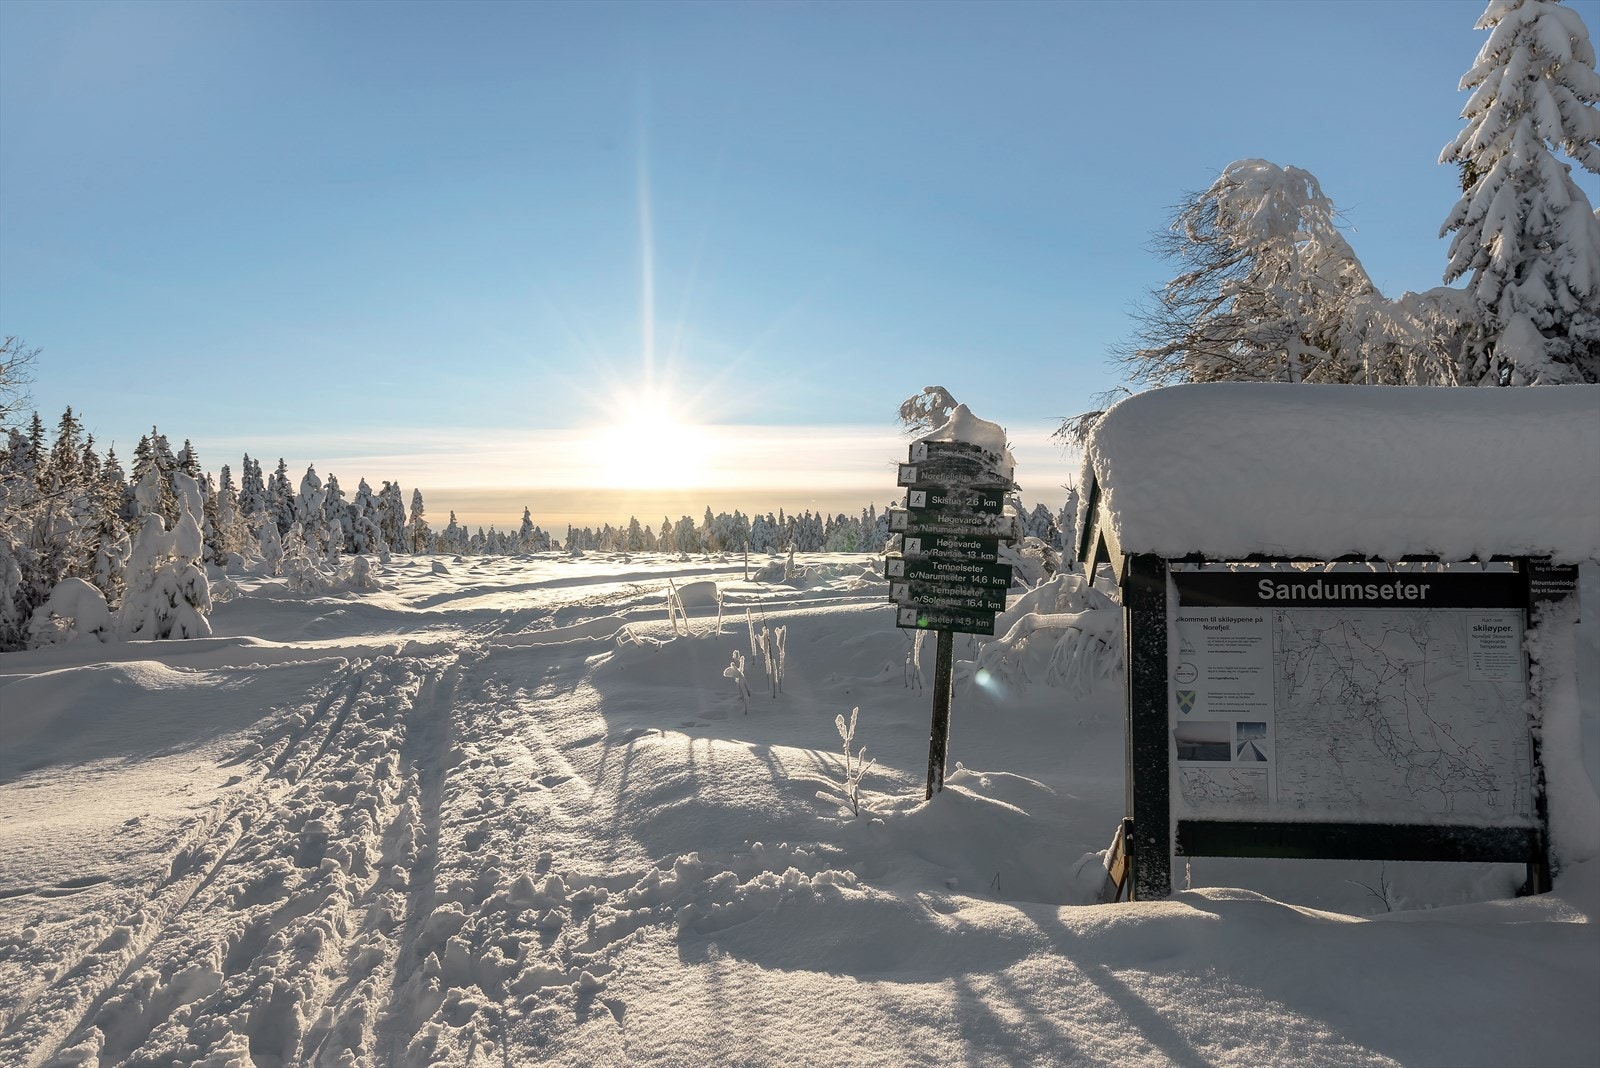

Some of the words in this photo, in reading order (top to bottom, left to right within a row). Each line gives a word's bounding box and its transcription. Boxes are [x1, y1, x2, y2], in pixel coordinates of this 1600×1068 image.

[984, 499, 997, 507] km
[936, 538, 981, 549] Høgevarde
[967, 551, 976, 559] 13
[981, 552, 994, 560] km
[932, 561, 984, 573] Tempelseter
[971, 575, 988, 584] 14.6
[992, 577, 1006, 585] km
[1258, 579, 1430, 600] Sandumseter
[967, 599, 983, 608] 16.4
[987, 600, 1001, 609] km
[976, 618, 989, 627] km
[1218, 616, 1254, 624] skiløypene
[1254, 616, 1264, 624] på
